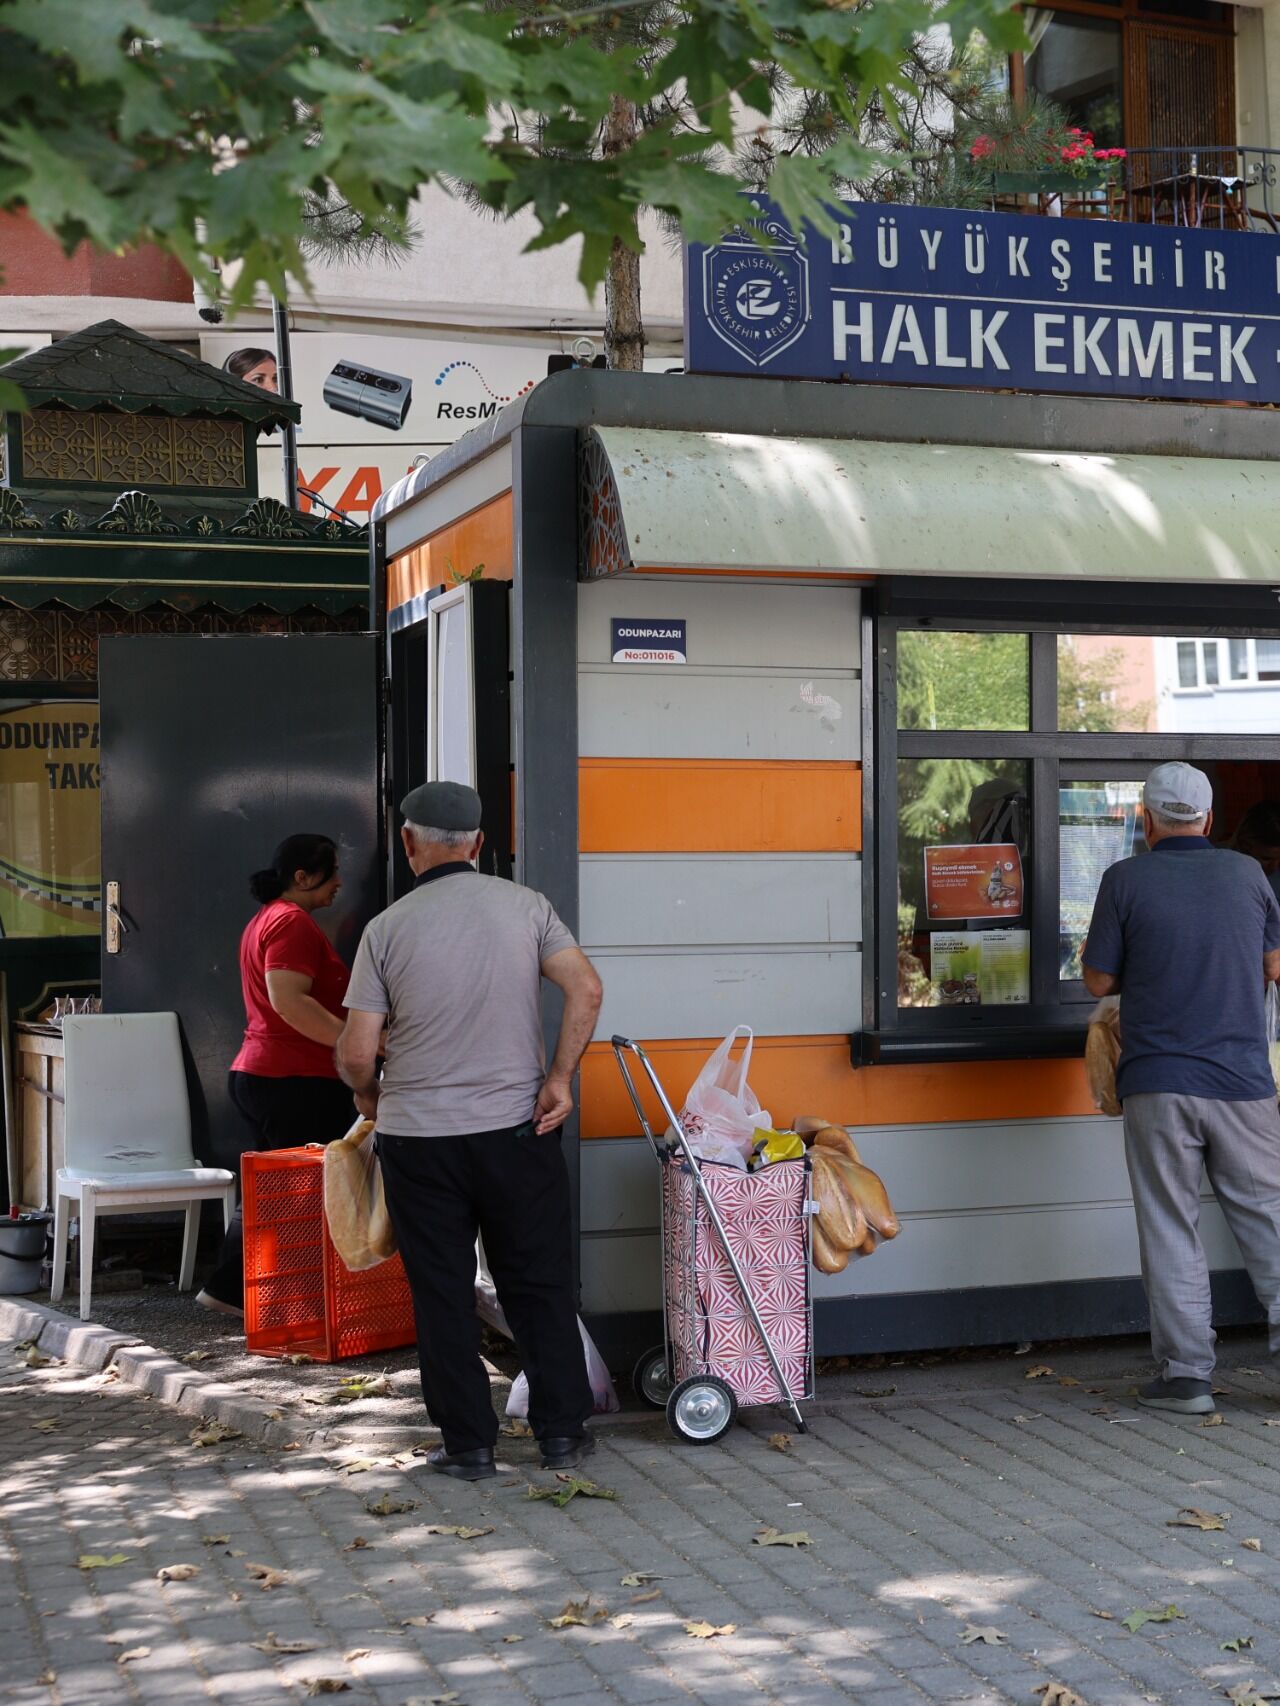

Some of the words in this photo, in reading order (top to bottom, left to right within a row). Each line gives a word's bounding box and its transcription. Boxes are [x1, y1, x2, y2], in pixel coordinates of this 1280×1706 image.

[831, 216, 1227, 292] BÜYÜKŞEHİR
[832, 300, 1011, 371] HALK
[1034, 312, 1258, 385] EKMEK
[436, 402, 504, 419] ResM
[617, 627, 682, 639] ODUNPAZARI
